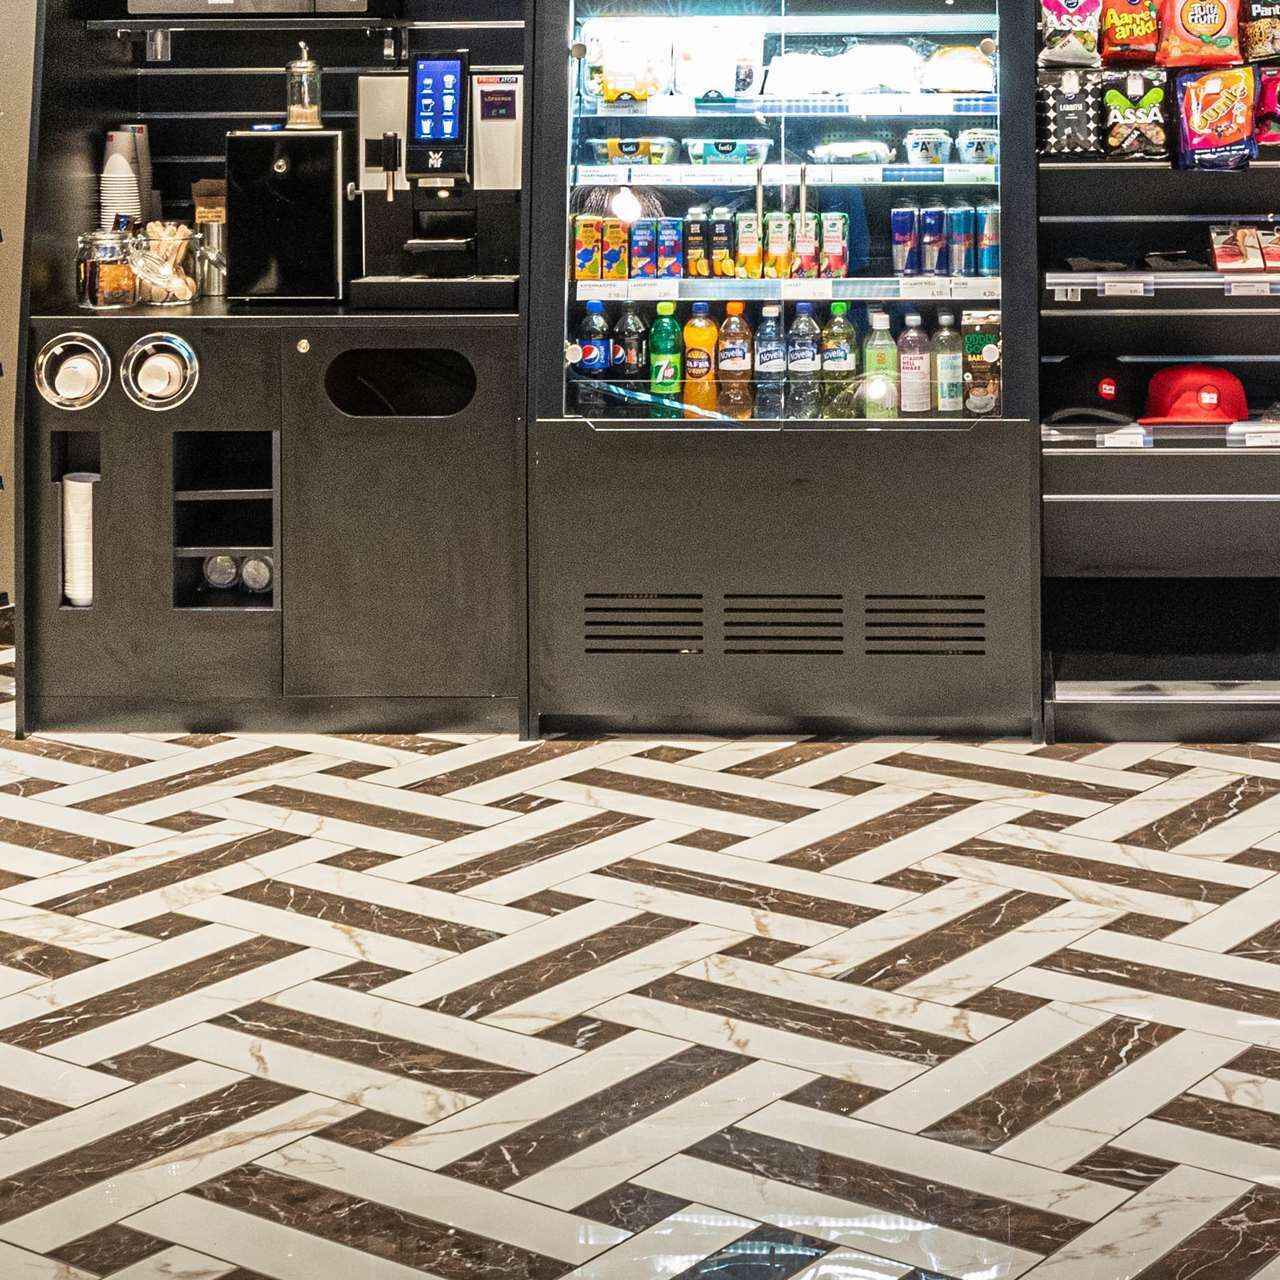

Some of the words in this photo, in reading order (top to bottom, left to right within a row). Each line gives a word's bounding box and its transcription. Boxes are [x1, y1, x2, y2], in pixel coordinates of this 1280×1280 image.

[1047, 11, 1098, 31] ÄSSÄ
[1107, 103, 1165, 127] ÄSSÄ
[720, 349, 744, 360] Novelle
[761, 350, 785, 362] Novelle
[790, 349, 813, 360] Novelle
